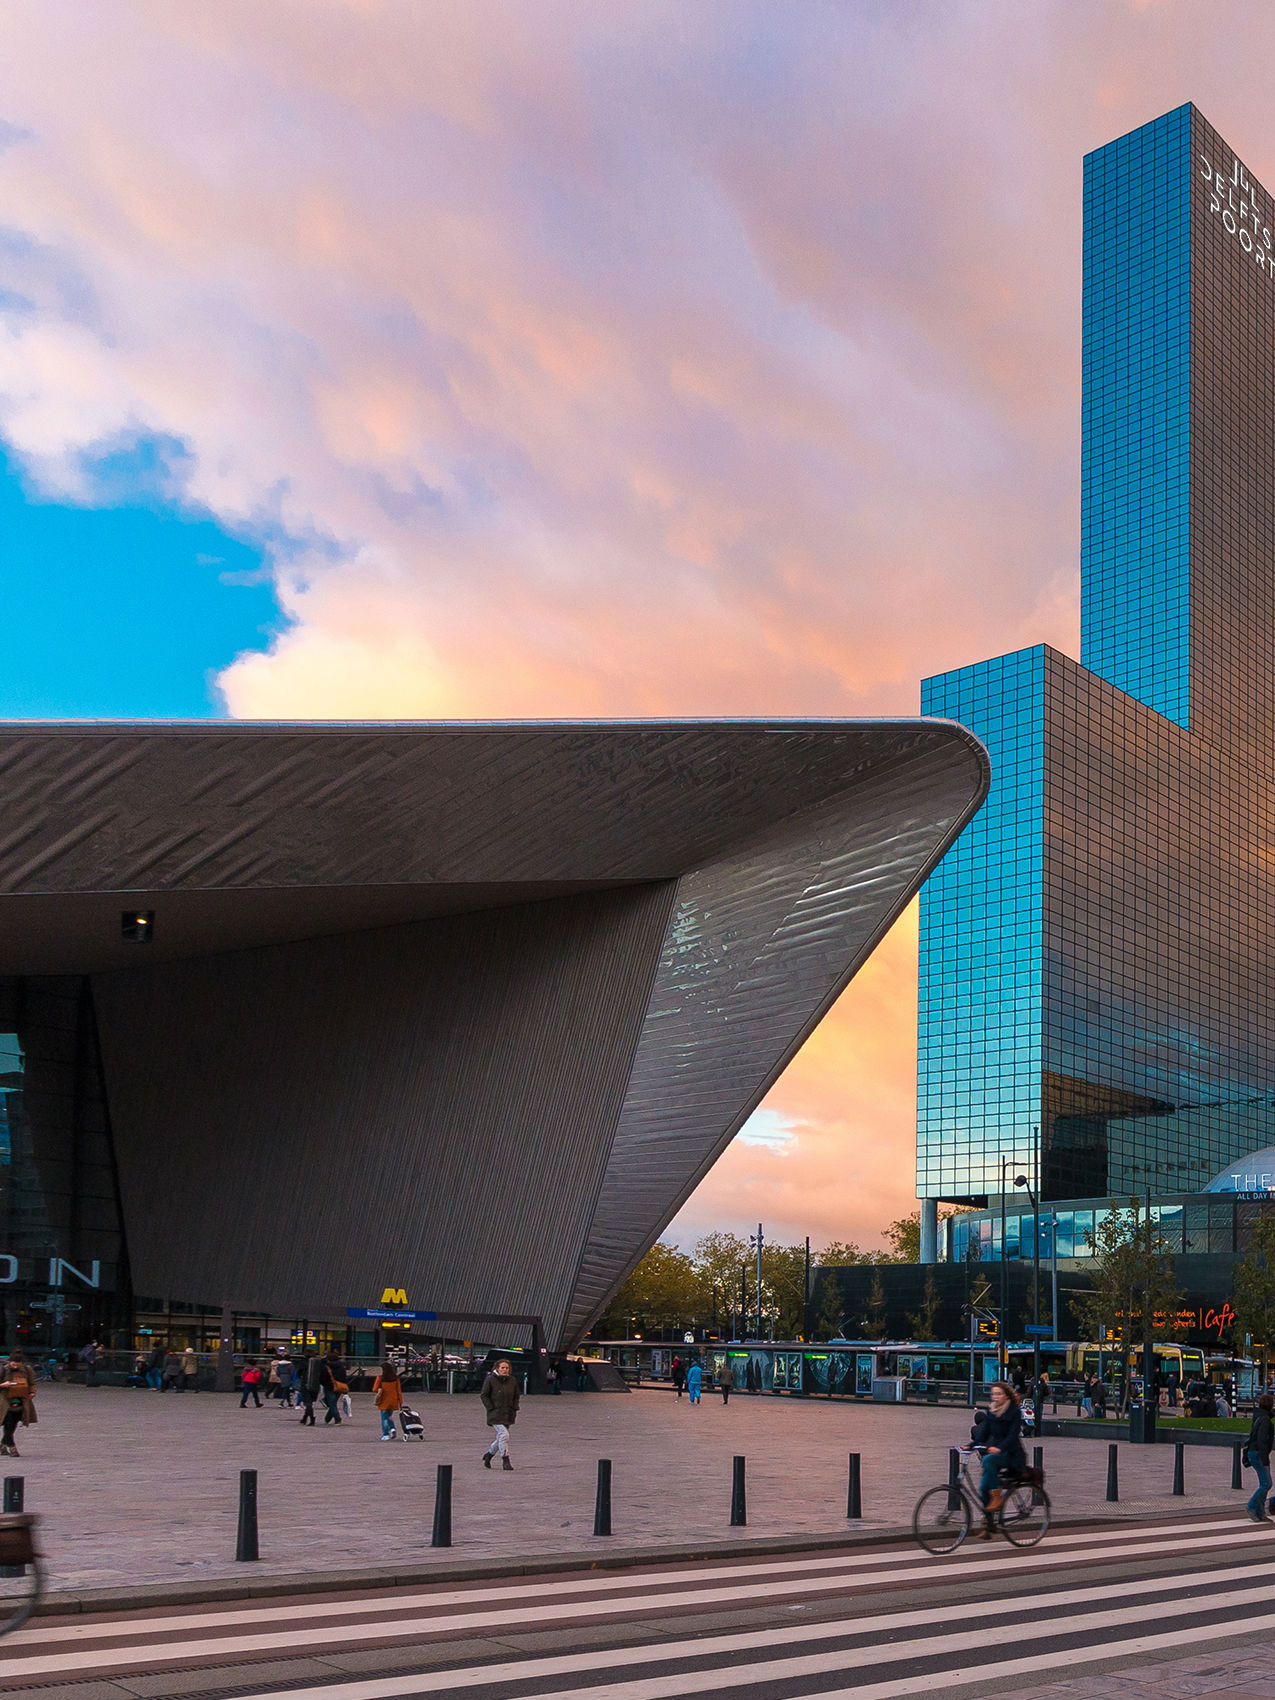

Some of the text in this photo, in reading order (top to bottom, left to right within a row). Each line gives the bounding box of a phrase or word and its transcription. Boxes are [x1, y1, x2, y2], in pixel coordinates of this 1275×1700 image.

[1210, 192, 1275, 279] POORT
[1231, 1173, 1271, 1191] THE
[1252, 1192, 1268, 1200] DAY
[1204, 1304, 1238, 1336] Café
